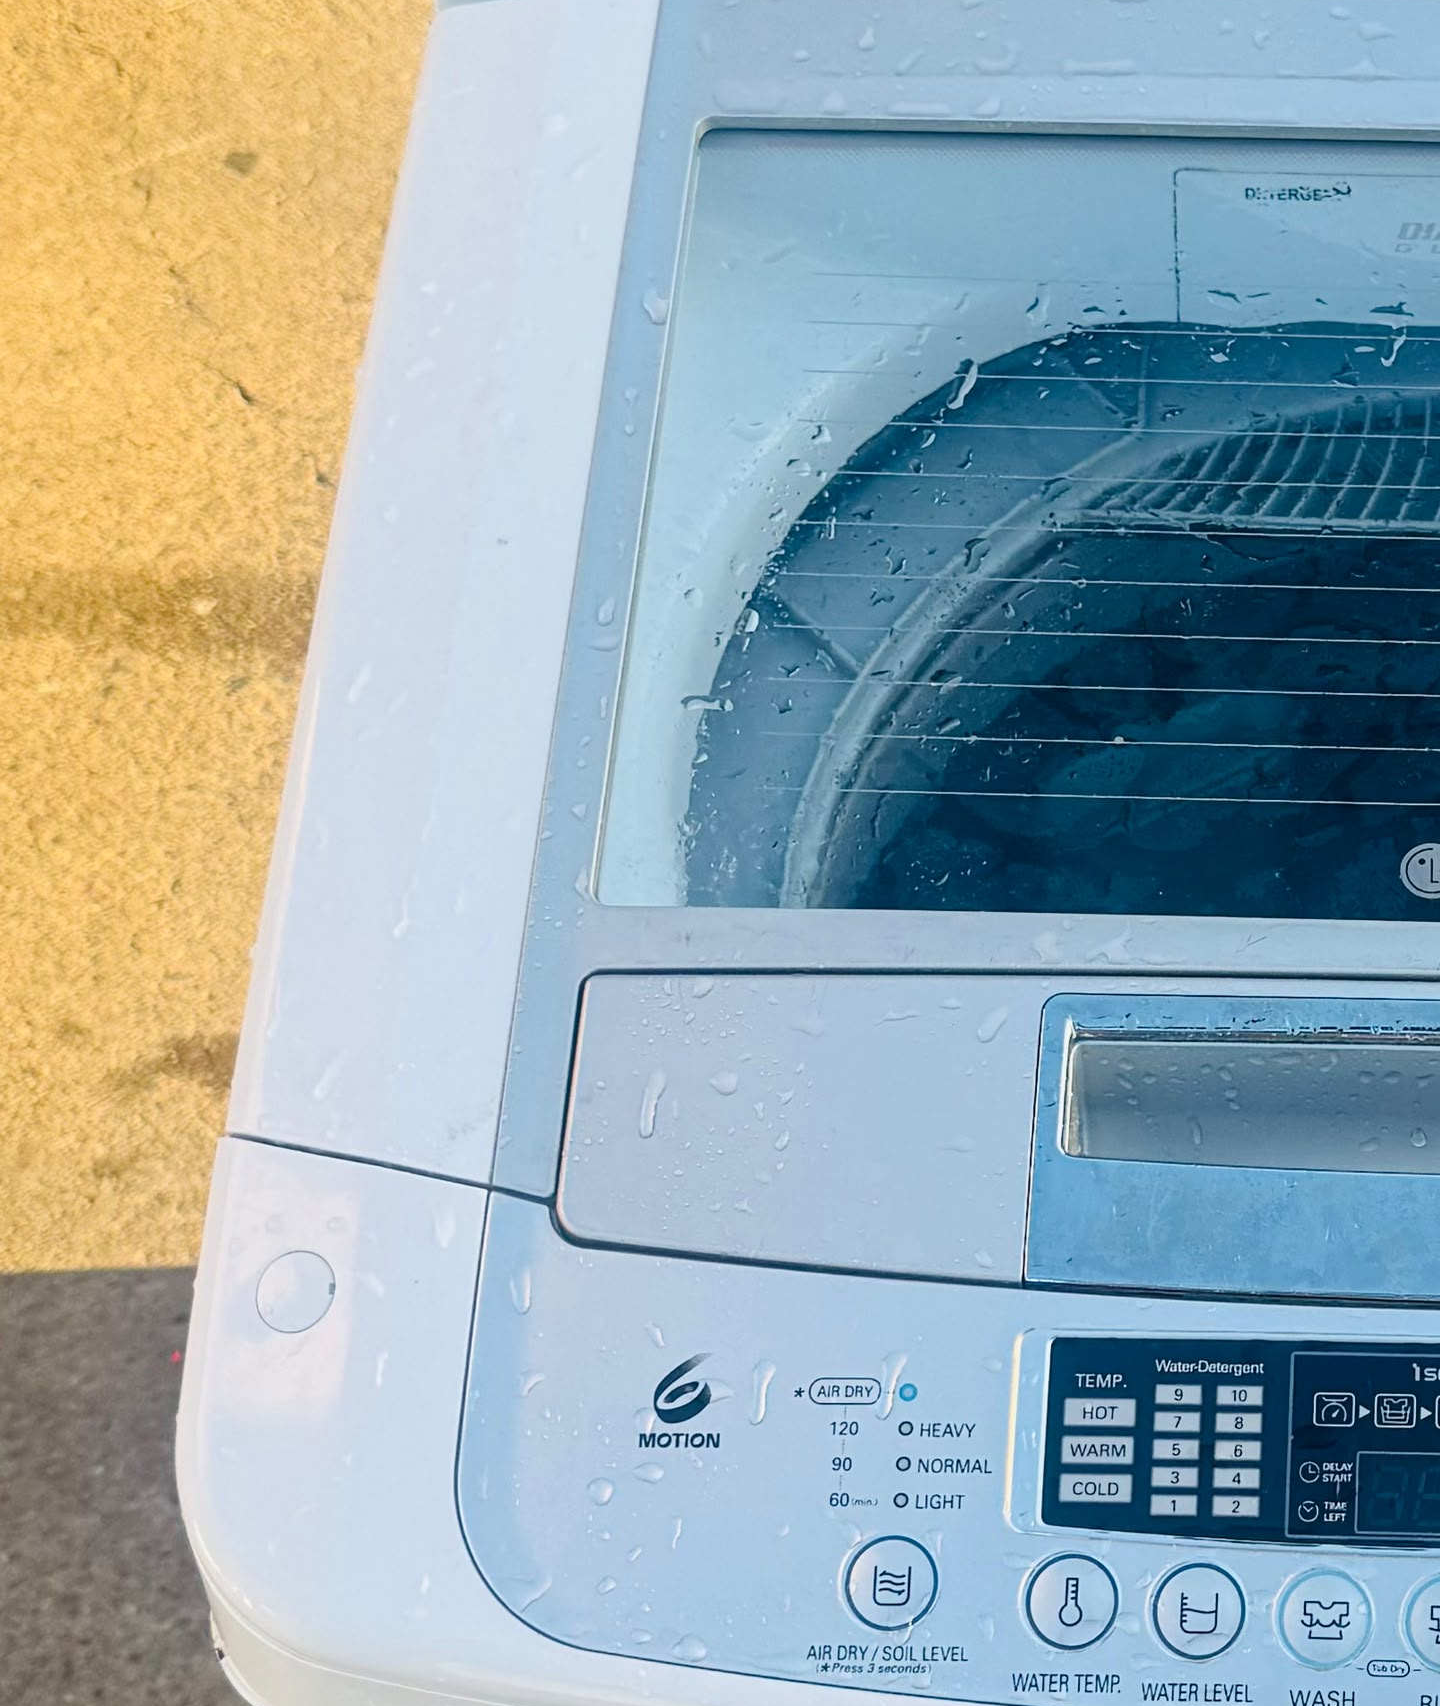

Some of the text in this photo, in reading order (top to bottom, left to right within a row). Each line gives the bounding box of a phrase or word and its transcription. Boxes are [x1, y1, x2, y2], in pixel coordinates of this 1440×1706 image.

[1076, 1374, 1128, 1389] TEMP.
[817, 1384, 874, 1399] AIR DRY
[1174, 1388, 1248, 1403] 9 10
[1082, 1405, 1119, 1421] HOT
[829, 1421, 976, 1439] 120 HEAVY
[1172, 1415, 1244, 1430] 7 8
[638, 1433, 721, 1448] MOTION
[1070, 1443, 1127, 1459] WARM
[1171, 1443, 1243, 1458] 5 6
[831, 1457, 992, 1475] 90 NORMAL
[1322, 1462, 1353, 1471] DELAY
[1170, 1471, 1242, 1486] 3 4
[1322, 1473, 1352, 1483] START
[1072, 1481, 1119, 1497] COLD
[829, 1493, 850, 1508] 60
[915, 1494, 966, 1510] LIGHT
[1170, 1499, 1241, 1514] 1 2
[1324, 1501, 1348, 1510] TIME
[1323, 1513, 1346, 1522] LEFT
[807, 1646, 832, 1661] AIR
[837, 1646, 869, 1661] DRY
[882, 1646, 917, 1662] SOIL
[923, 1647, 968, 1662] LEVEL
[867, 1663, 875, 1673] 3
[1012, 1673, 1121, 1694] WATER TEMP.
[1141, 1683, 1253, 1703] WATER LEVEL
